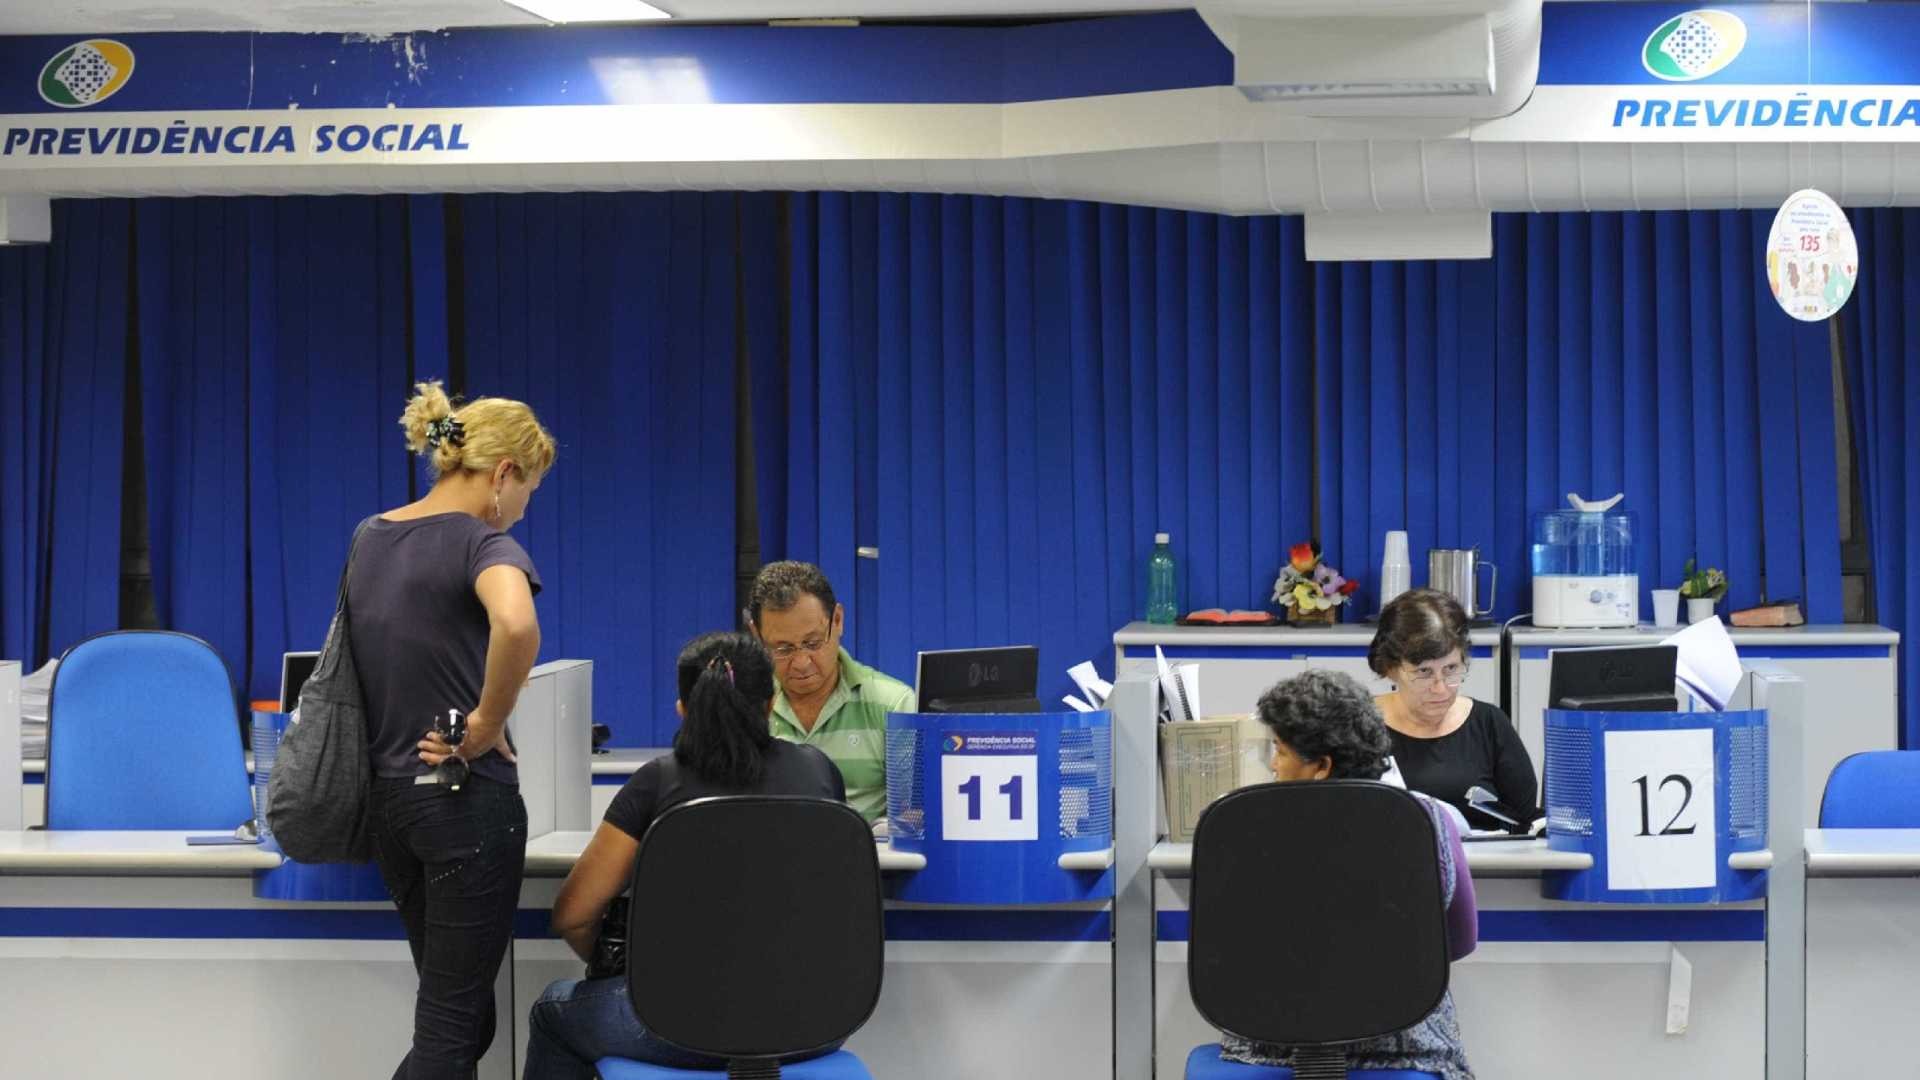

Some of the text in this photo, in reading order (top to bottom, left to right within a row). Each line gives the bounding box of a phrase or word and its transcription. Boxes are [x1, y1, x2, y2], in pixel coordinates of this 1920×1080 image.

[1613, 92, 1920, 127] PREVIDÊNCIA
[3, 120, 469, 155] PREVIDÊNCIA SOCIAL
[1800, 235, 1820, 252] 135
[958, 775, 1023, 821] 11
[1631, 773, 1697, 837] 12
